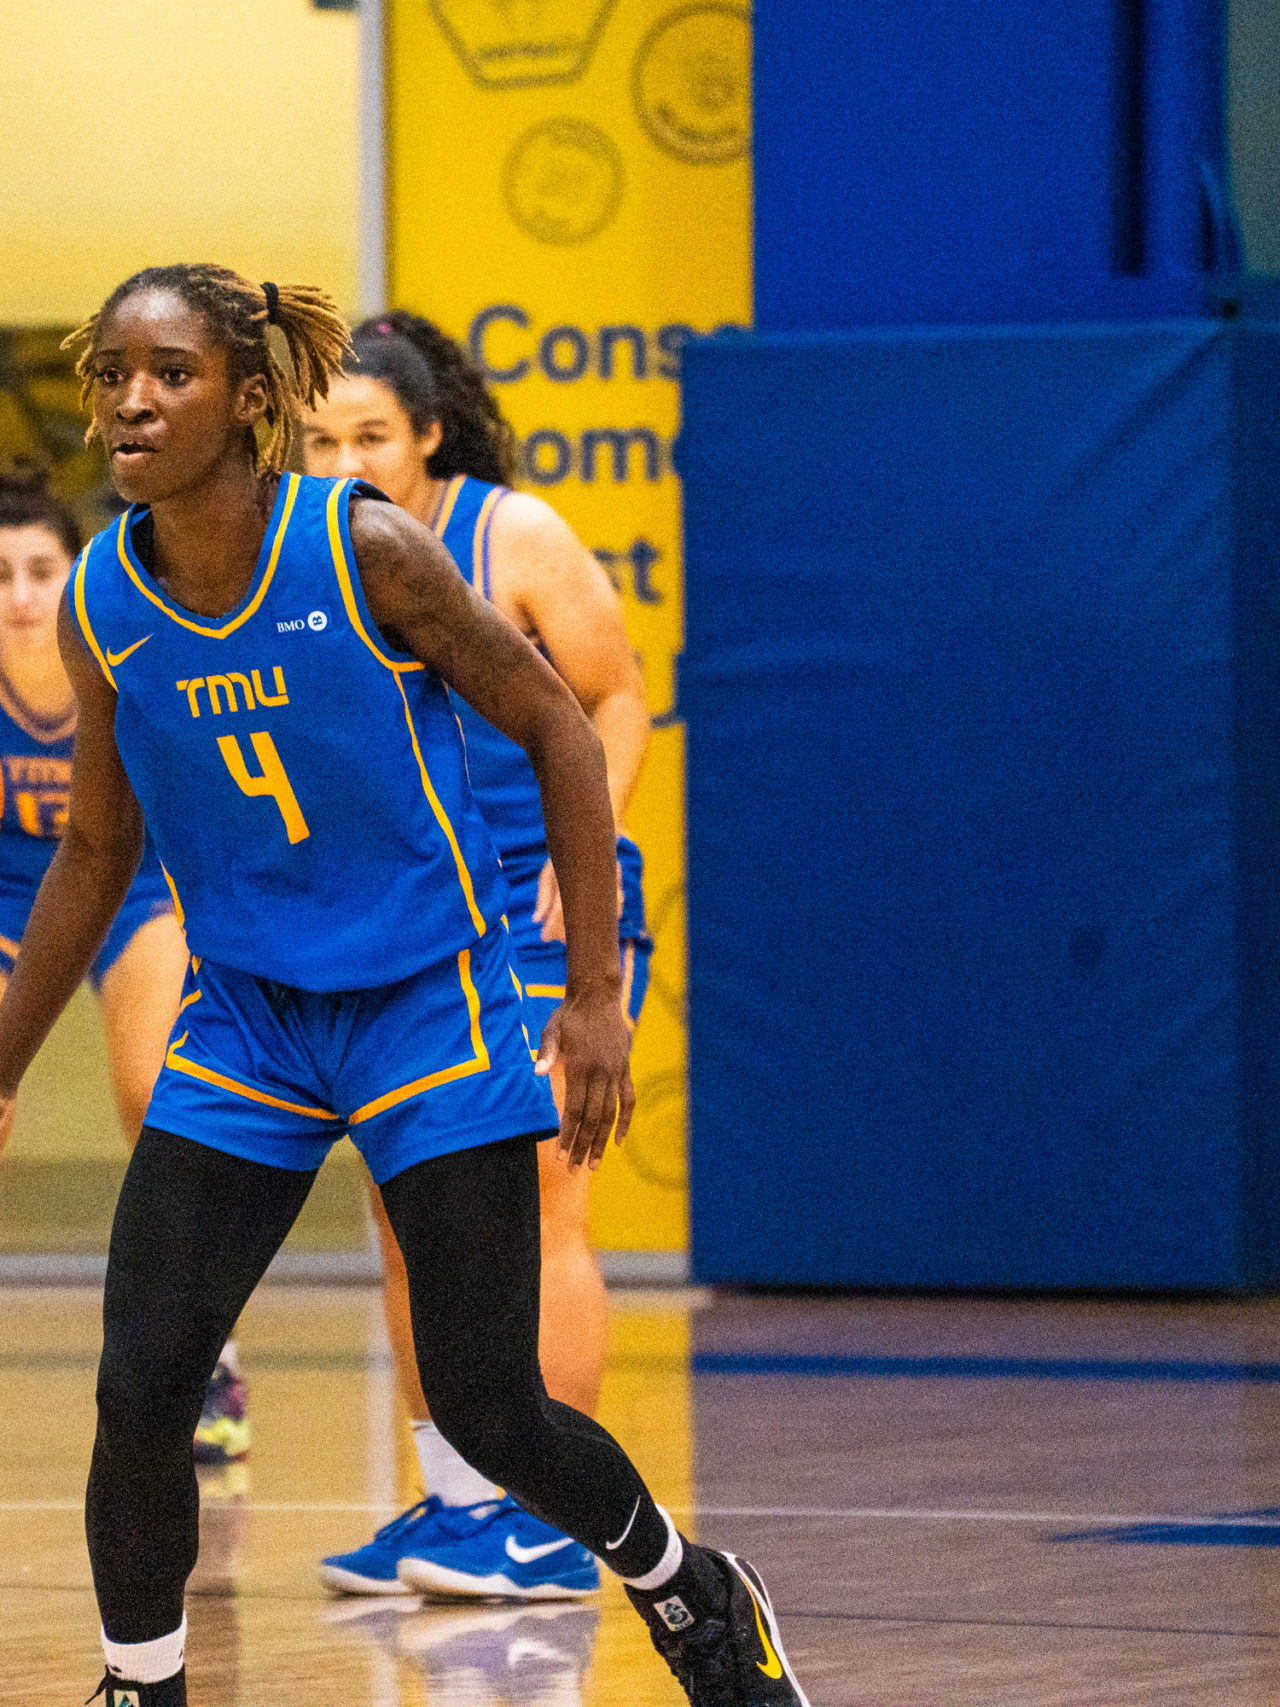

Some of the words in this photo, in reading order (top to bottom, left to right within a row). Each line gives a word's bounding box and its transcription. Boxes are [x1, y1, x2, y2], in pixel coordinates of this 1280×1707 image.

[468, 303, 754, 385] Cons
[276, 619, 305, 633] BMO
[176, 666, 290, 718] TMU
[216, 731, 310, 845] 4
